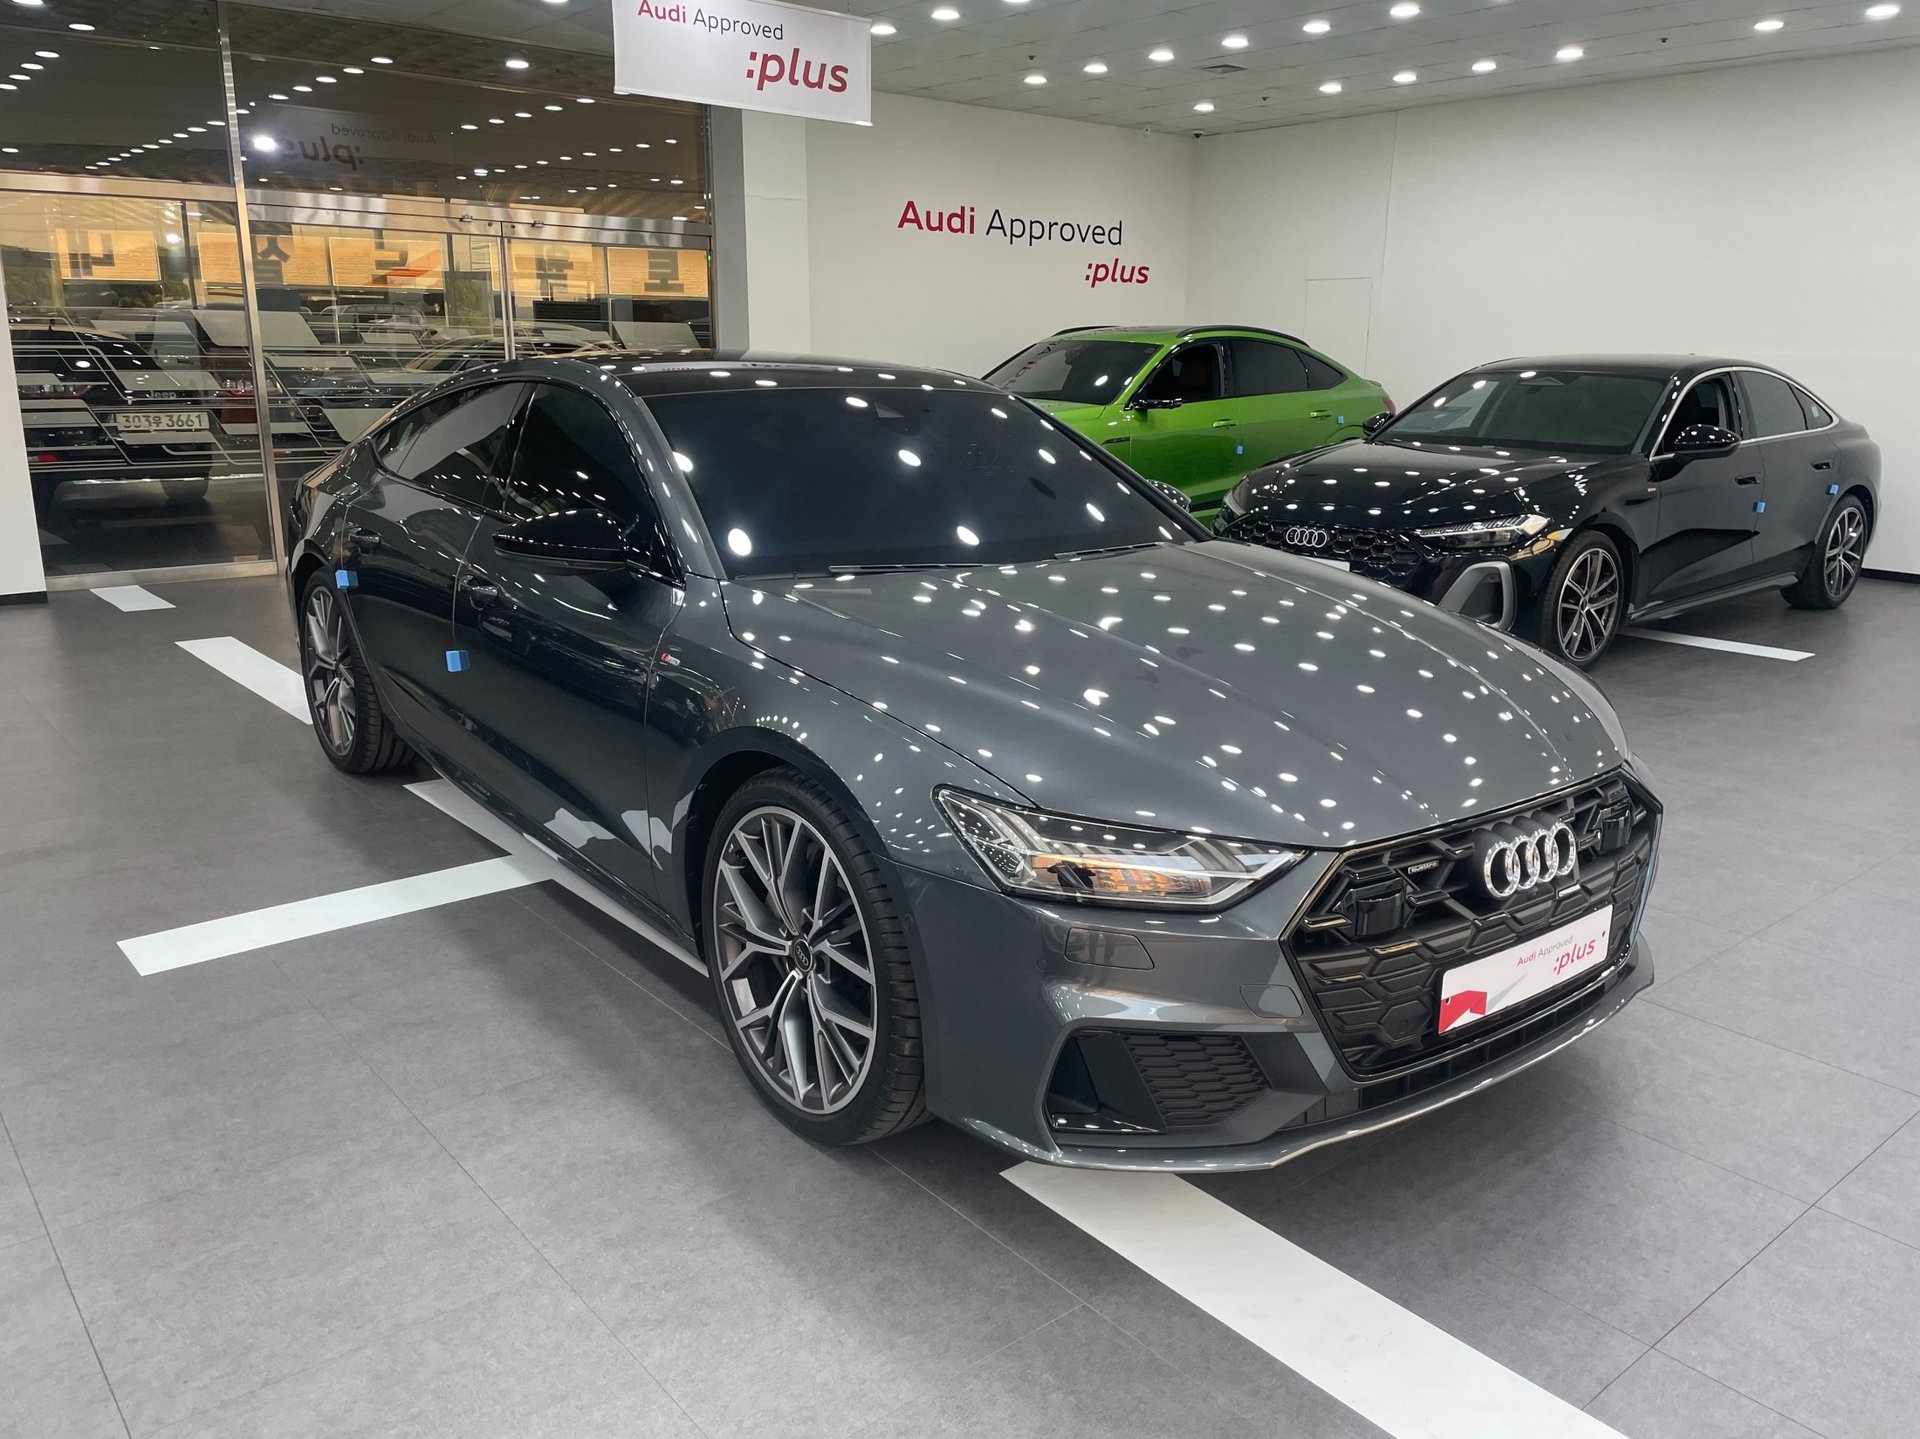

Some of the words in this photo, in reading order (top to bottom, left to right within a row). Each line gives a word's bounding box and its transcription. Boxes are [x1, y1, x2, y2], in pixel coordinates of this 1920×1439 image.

[638, 0, 687, 23] Audi
[693, 9, 783, 40] Approved
[746, 48, 849, 93] :plus
[898, 201, 975, 234] Audi
[986, 209, 1123, 246] Approved
[1085, 258, 1150, 288] :plus
[149, 390, 177, 399] Jeep
[165, 414, 203, 428] 3661
[1517, 952, 1537, 966] Audi
[1538, 935, 1574, 957] Approved
[1553, 939, 1596, 975] :plus
